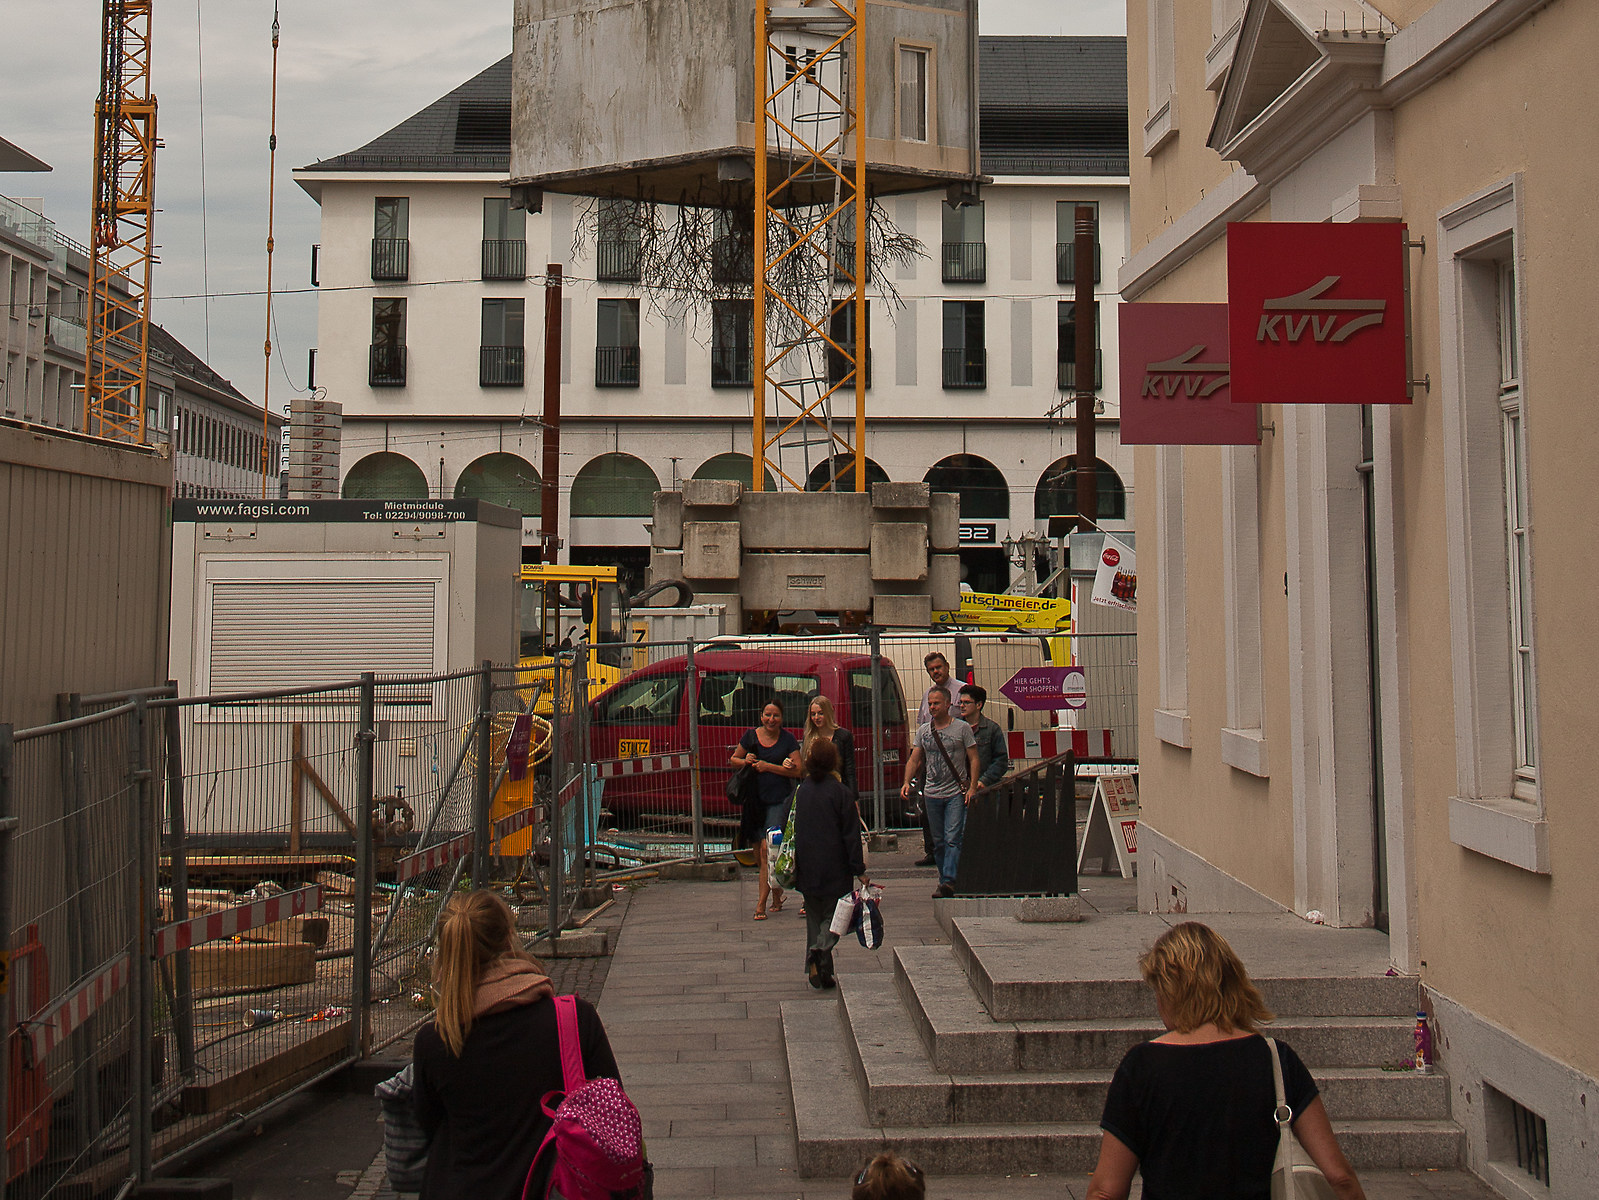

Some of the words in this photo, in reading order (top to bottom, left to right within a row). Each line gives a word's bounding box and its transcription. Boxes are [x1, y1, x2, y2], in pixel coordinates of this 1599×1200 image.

[1256, 314, 1337, 341] KVV
[1141, 375, 1203, 397] KVV
[196, 503, 310, 518] www.fagsi.com
[384, 501, 444, 510] Mietmodule
[362, 511, 382, 520] Tel:
